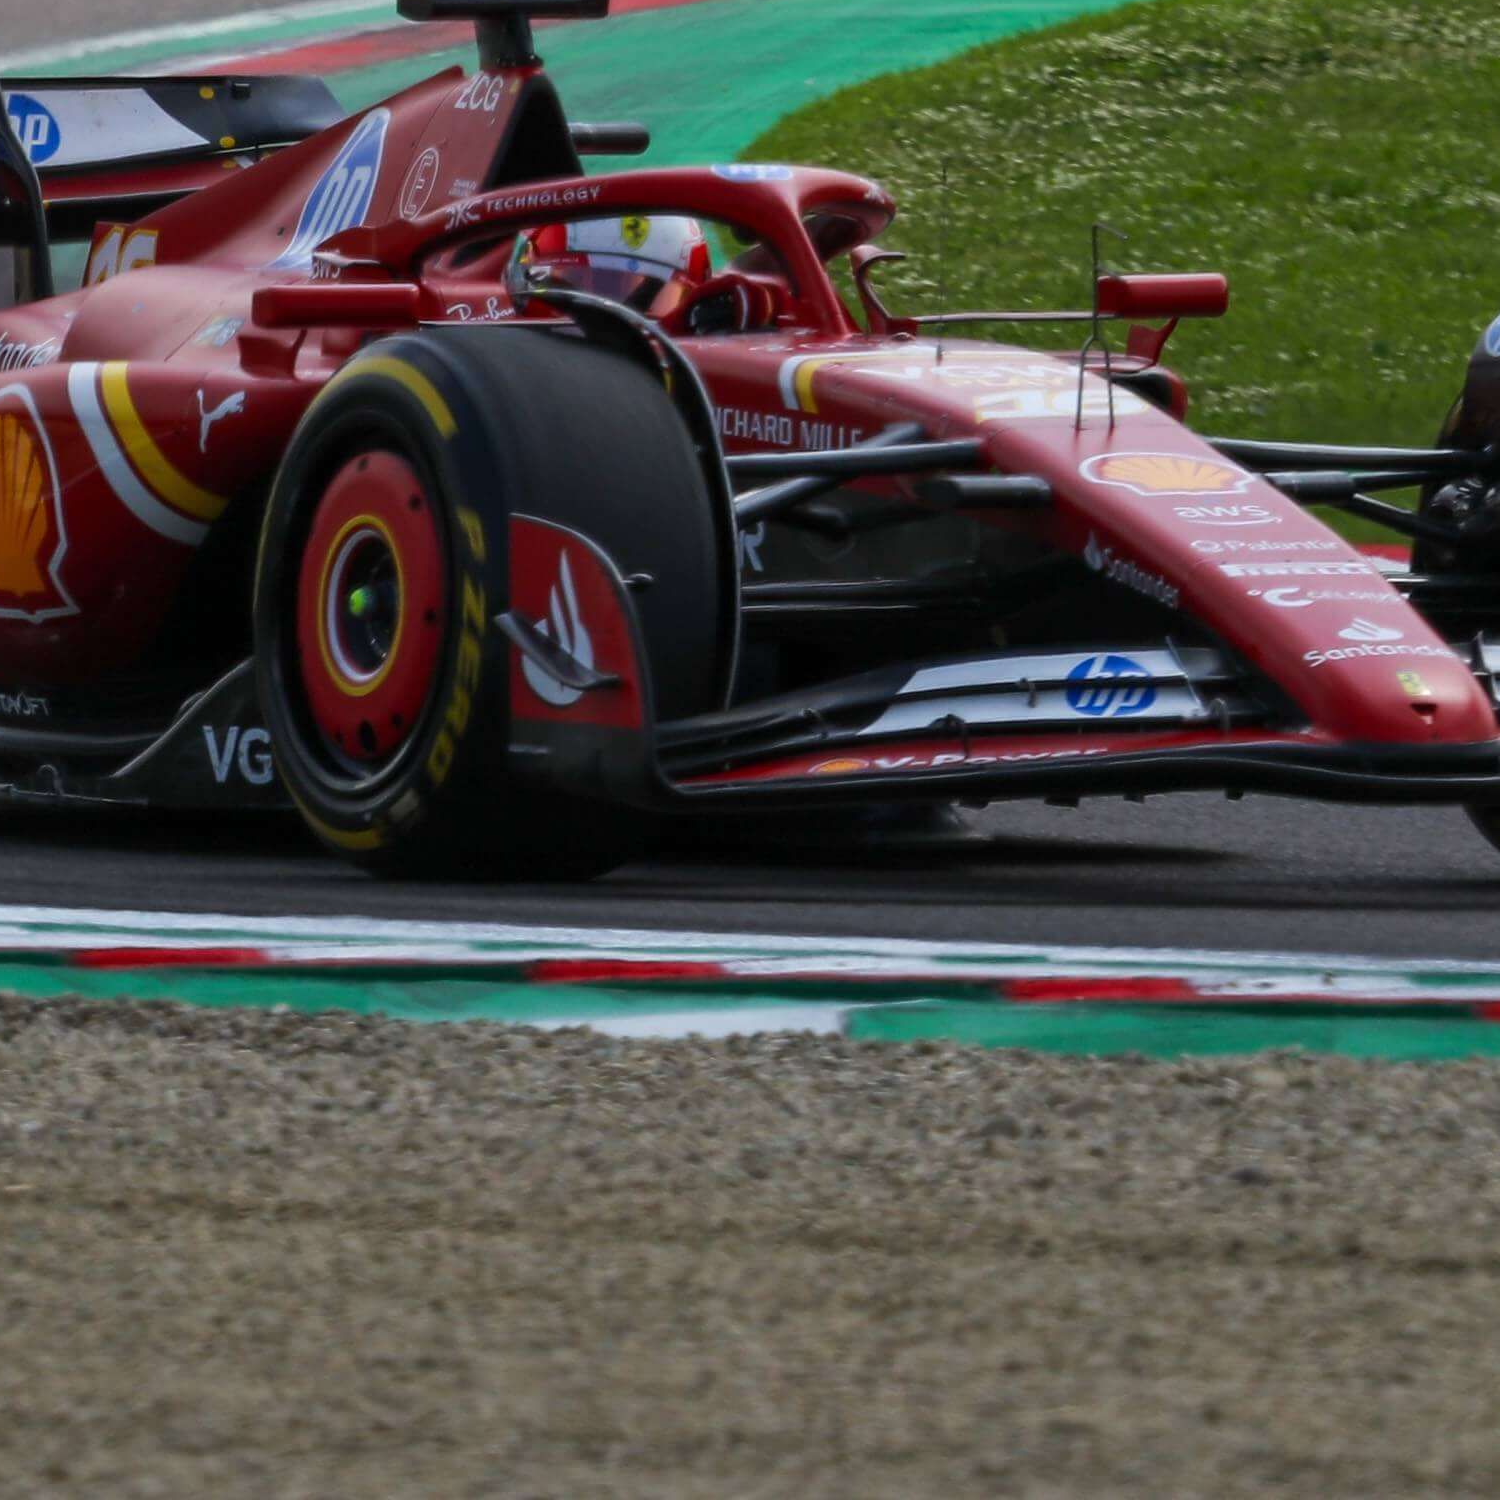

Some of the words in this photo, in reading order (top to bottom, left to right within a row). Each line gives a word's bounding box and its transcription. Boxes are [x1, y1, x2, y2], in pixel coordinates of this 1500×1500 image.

[486, 185, 601, 213] TECHNOLOGY
[713, 405, 793, 446] ICHARD
[1173, 504, 1271, 519] aws
[1075, 652, 1150, 717] hp
[202, 725, 274, 785] VG
